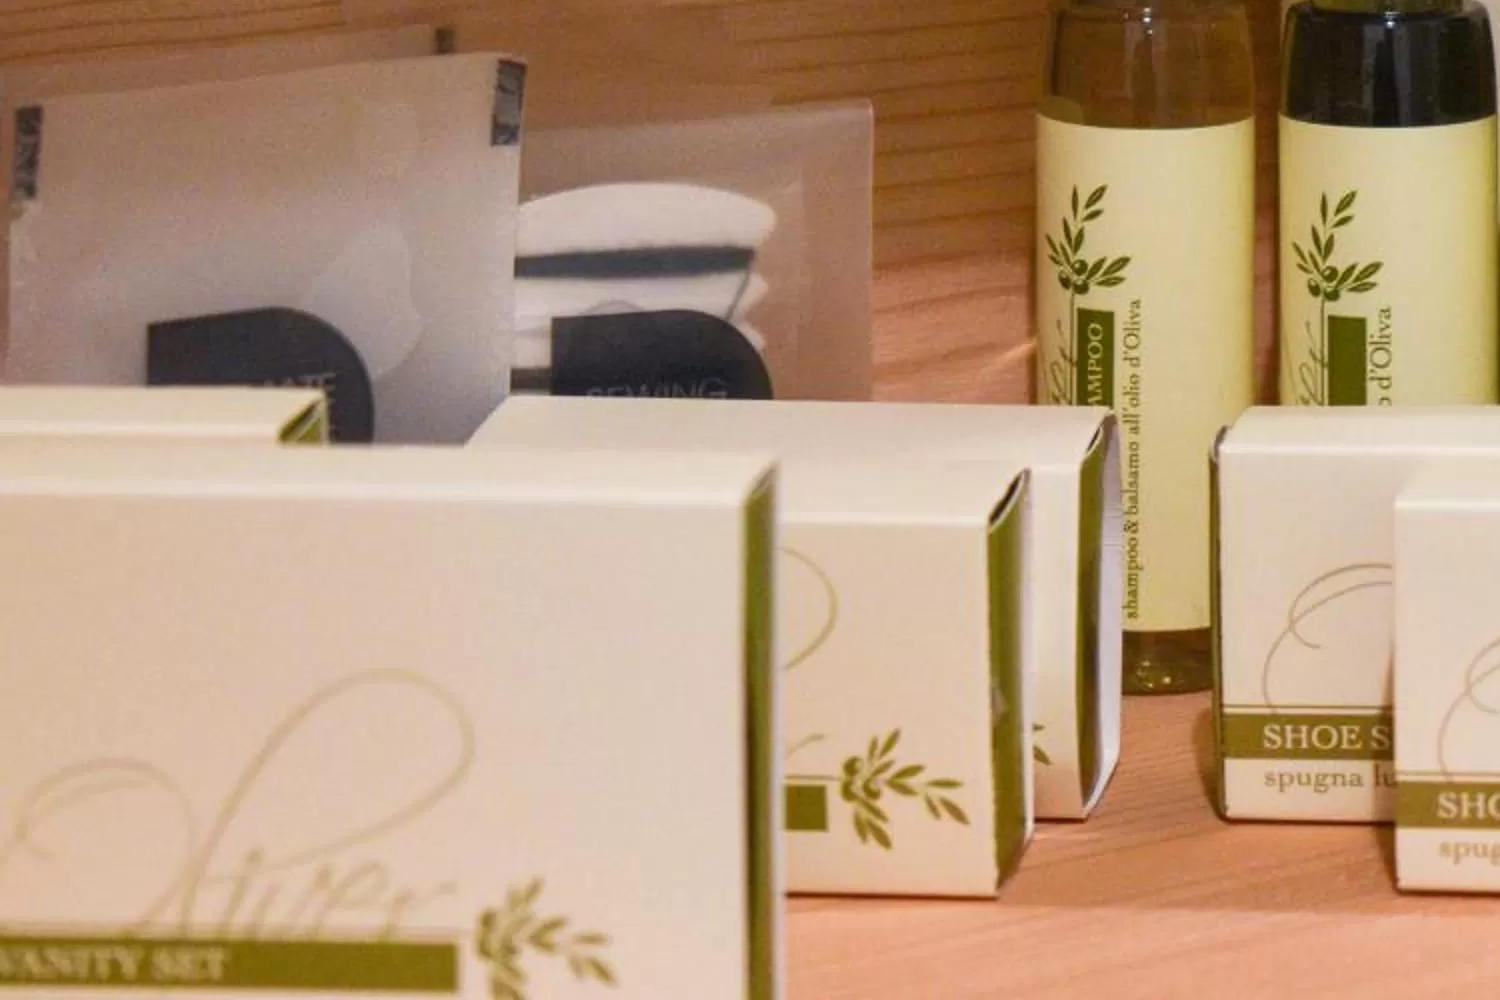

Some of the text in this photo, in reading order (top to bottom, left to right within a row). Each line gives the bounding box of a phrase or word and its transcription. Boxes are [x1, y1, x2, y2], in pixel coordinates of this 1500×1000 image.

[1368, 306, 1393, 391] d'Oliva
[1121, 299, 1145, 620] shampoo & balsamo all'olio d'Oliva
[1262, 723, 1364, 751] SHOE
[1263, 769, 1365, 794] spugna
[152, 947, 229, 981] SET
